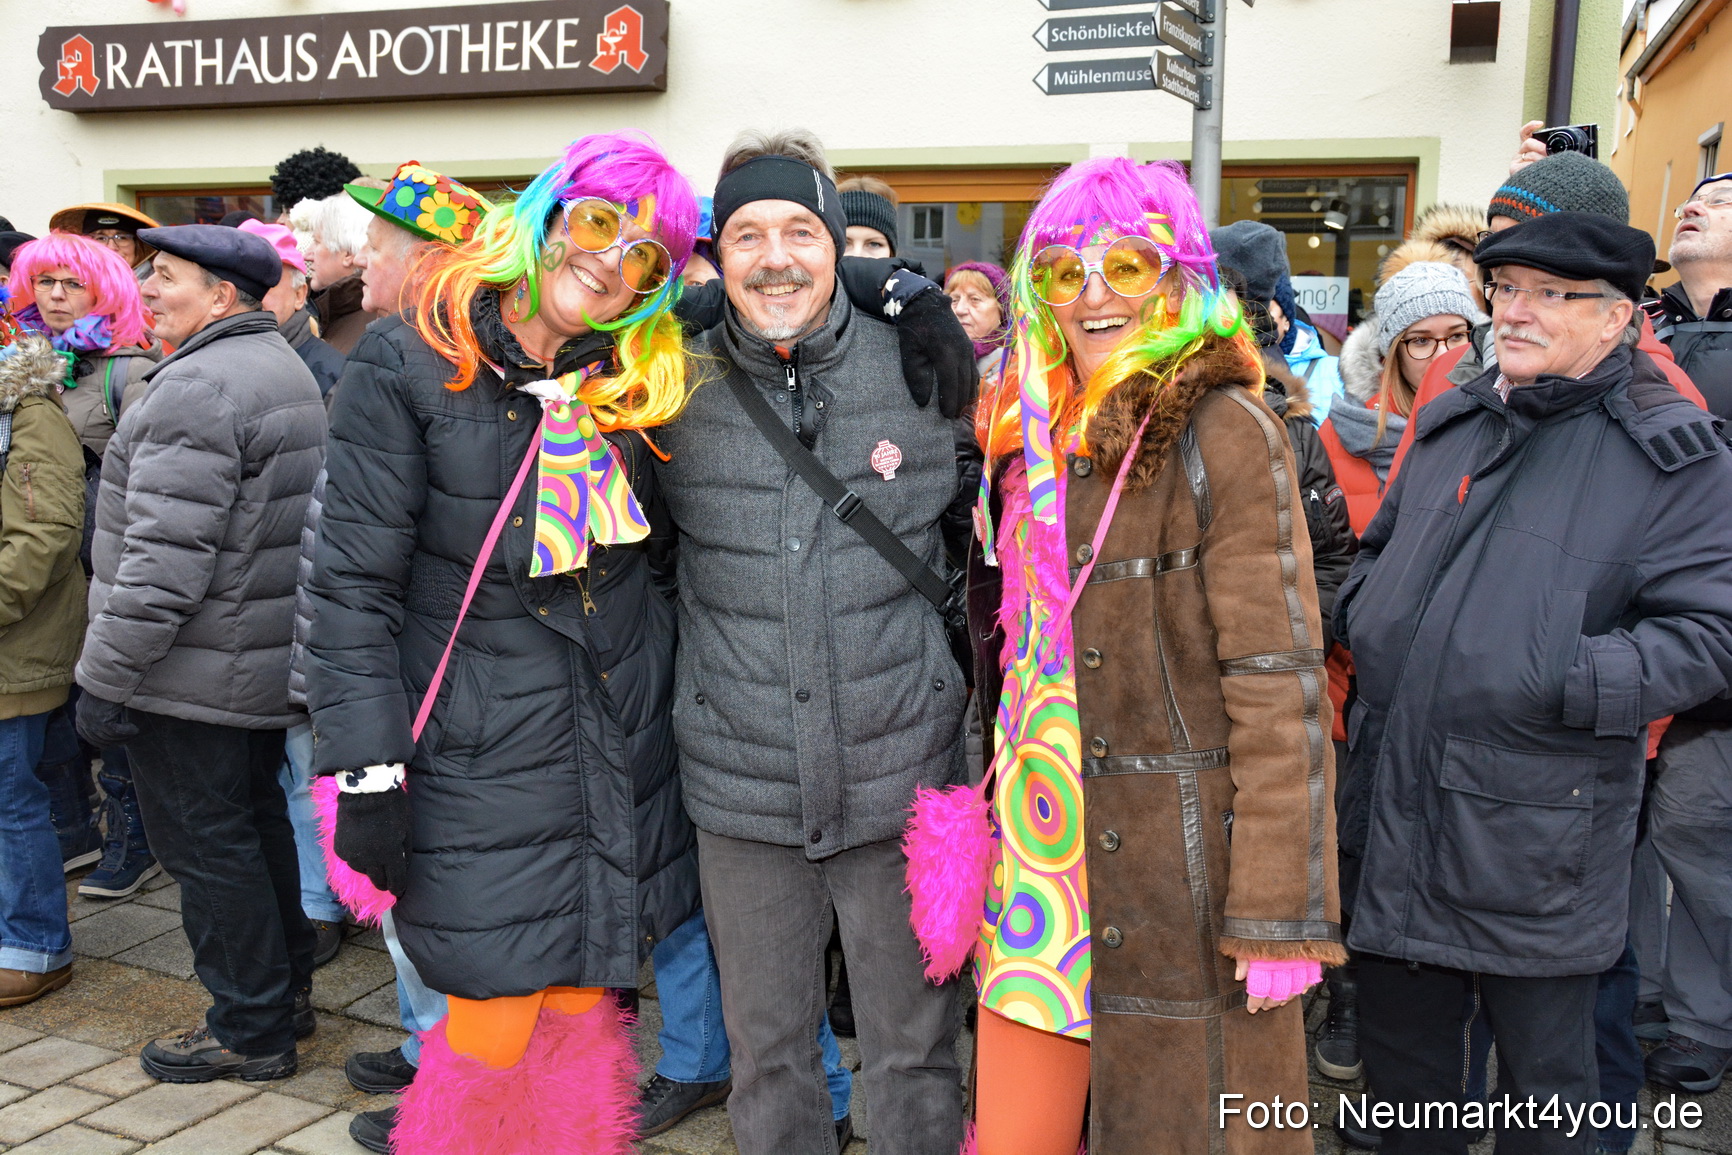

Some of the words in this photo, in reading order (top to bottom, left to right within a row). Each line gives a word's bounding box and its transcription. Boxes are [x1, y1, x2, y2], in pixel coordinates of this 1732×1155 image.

[1163, 15, 1202, 53] Franziskuspark
[105, 33, 318, 90] RATHAUS
[327, 18, 582, 80] APOTHEKE
[1054, 69, 1152, 86] Mühlenmuse
[1166, 57, 1197, 85] Kulturhaus
[1162, 73, 1200, 103] Stadtbücherei
